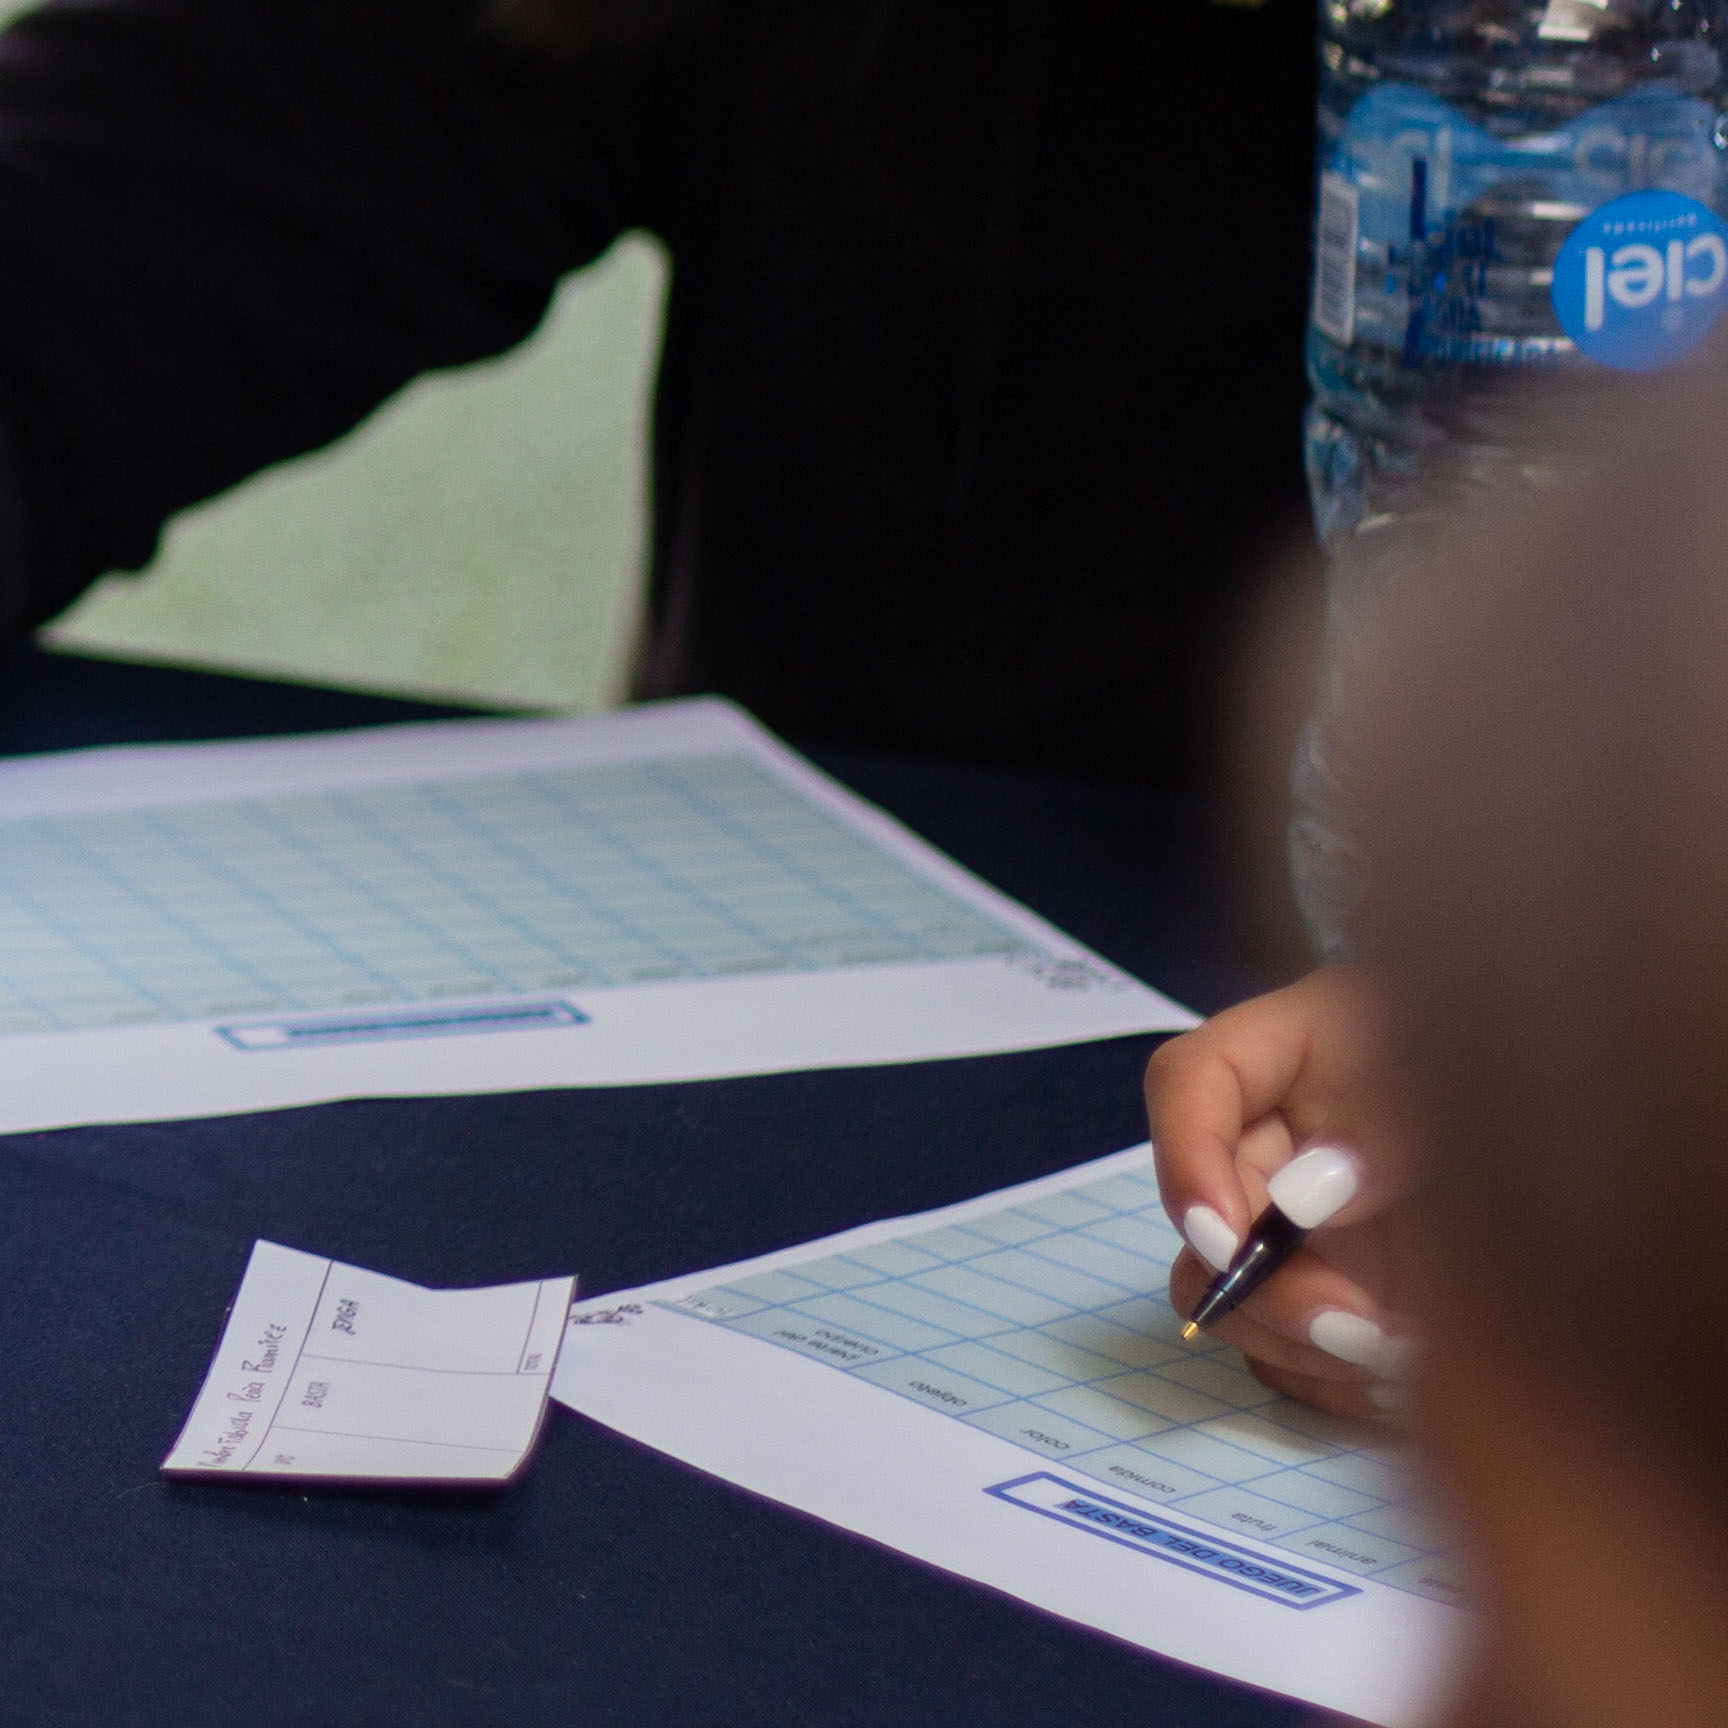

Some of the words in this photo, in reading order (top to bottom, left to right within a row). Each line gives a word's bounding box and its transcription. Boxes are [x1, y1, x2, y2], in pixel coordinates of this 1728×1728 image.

[1583, 232, 1728, 332] ciel
[1021, 1428, 1070, 1451] color
[1107, 1464, 1177, 1494] comida
[1062, 1499, 1158, 1537] BASTA
[1231, 1511, 1278, 1532] fruta
[1163, 1535, 1219, 1560] DEL
[1309, 1538, 1378, 1565] animal
[1218, 1558, 1322, 1596] JUEGO
